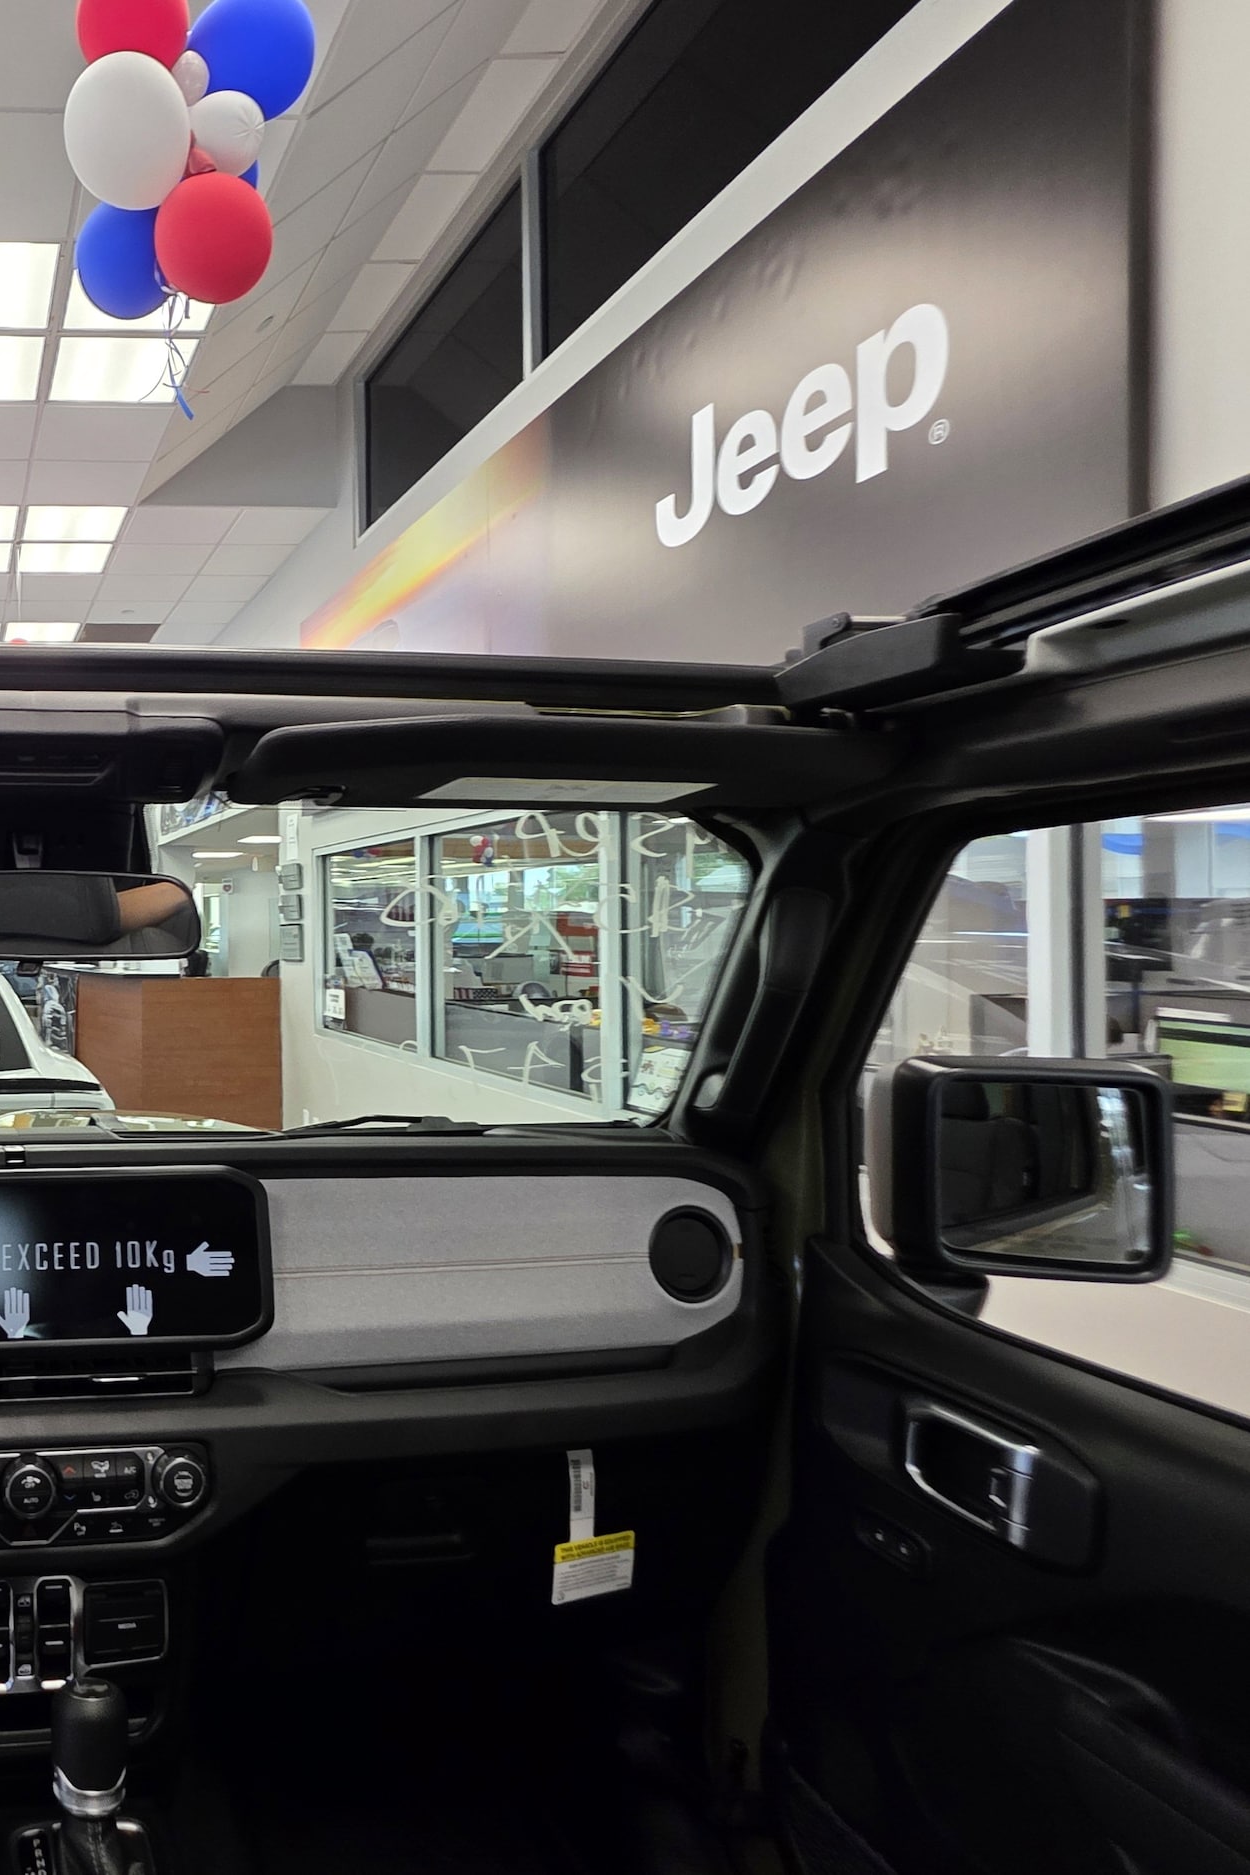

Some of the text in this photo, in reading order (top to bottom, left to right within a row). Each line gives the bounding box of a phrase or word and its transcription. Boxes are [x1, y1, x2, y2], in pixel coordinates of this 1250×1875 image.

[655, 303, 949, 548] Jeep
[1, 1241, 101, 1272] EXCEED
[114, 1239, 177, 1274] 10Kg
